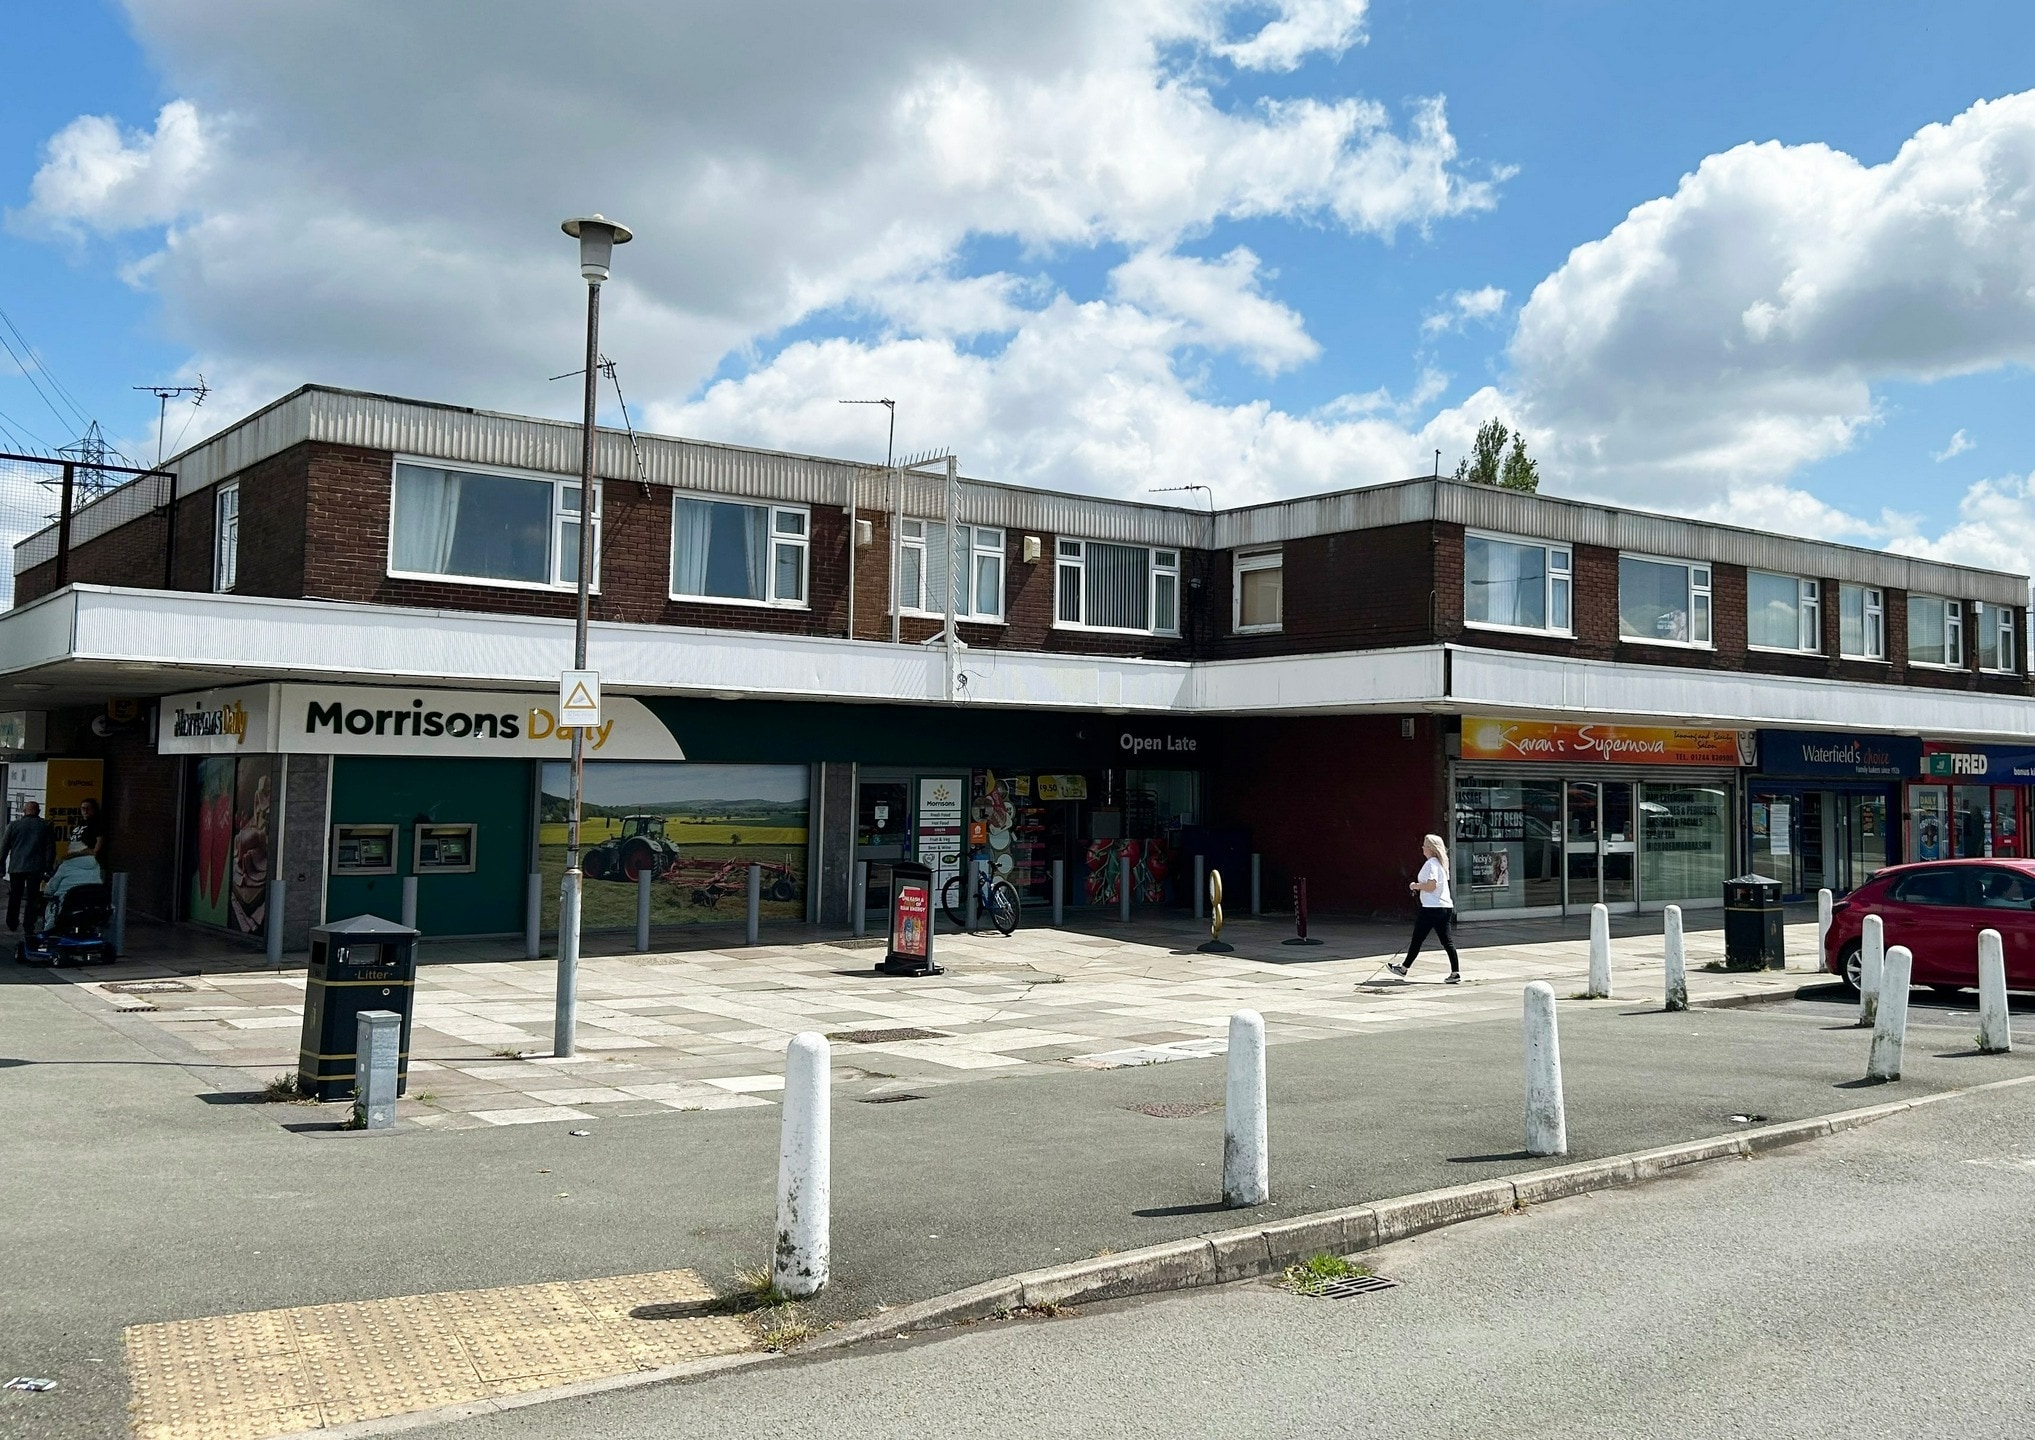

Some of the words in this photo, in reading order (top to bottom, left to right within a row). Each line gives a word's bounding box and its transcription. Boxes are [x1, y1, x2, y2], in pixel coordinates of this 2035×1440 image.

[174, 701, 222, 737] Morrisons
[222, 699, 248, 745] Daily
[305, 699, 519, 740] Morrisons
[527, 707, 614, 751] Day
[1497, 723, 1564, 756] Karan's
[1573, 725, 1665, 760] Supernova
[1698, 731, 1710, 740] and
[1120, 733, 1162, 754] Open
[1167, 735, 1197, 751] Late
[1697, 741, 1717, 750] Salon
[1802, 741, 1861, 764] Waterfield's
[1863, 747, 1890, 765] choice
[1930, 752, 1988, 774] TFRED
[2013, 767, 2030, 776] bonus
[68, 779, 94, 787] InPost
[926, 799, 956, 808] Morrisons
[1456, 811, 1488, 839] 25%
[1504, 811, 1524, 827] BEDS
[1472, 854, 1492, 864] Nicky's
[357, 970, 389, 980] Litter
